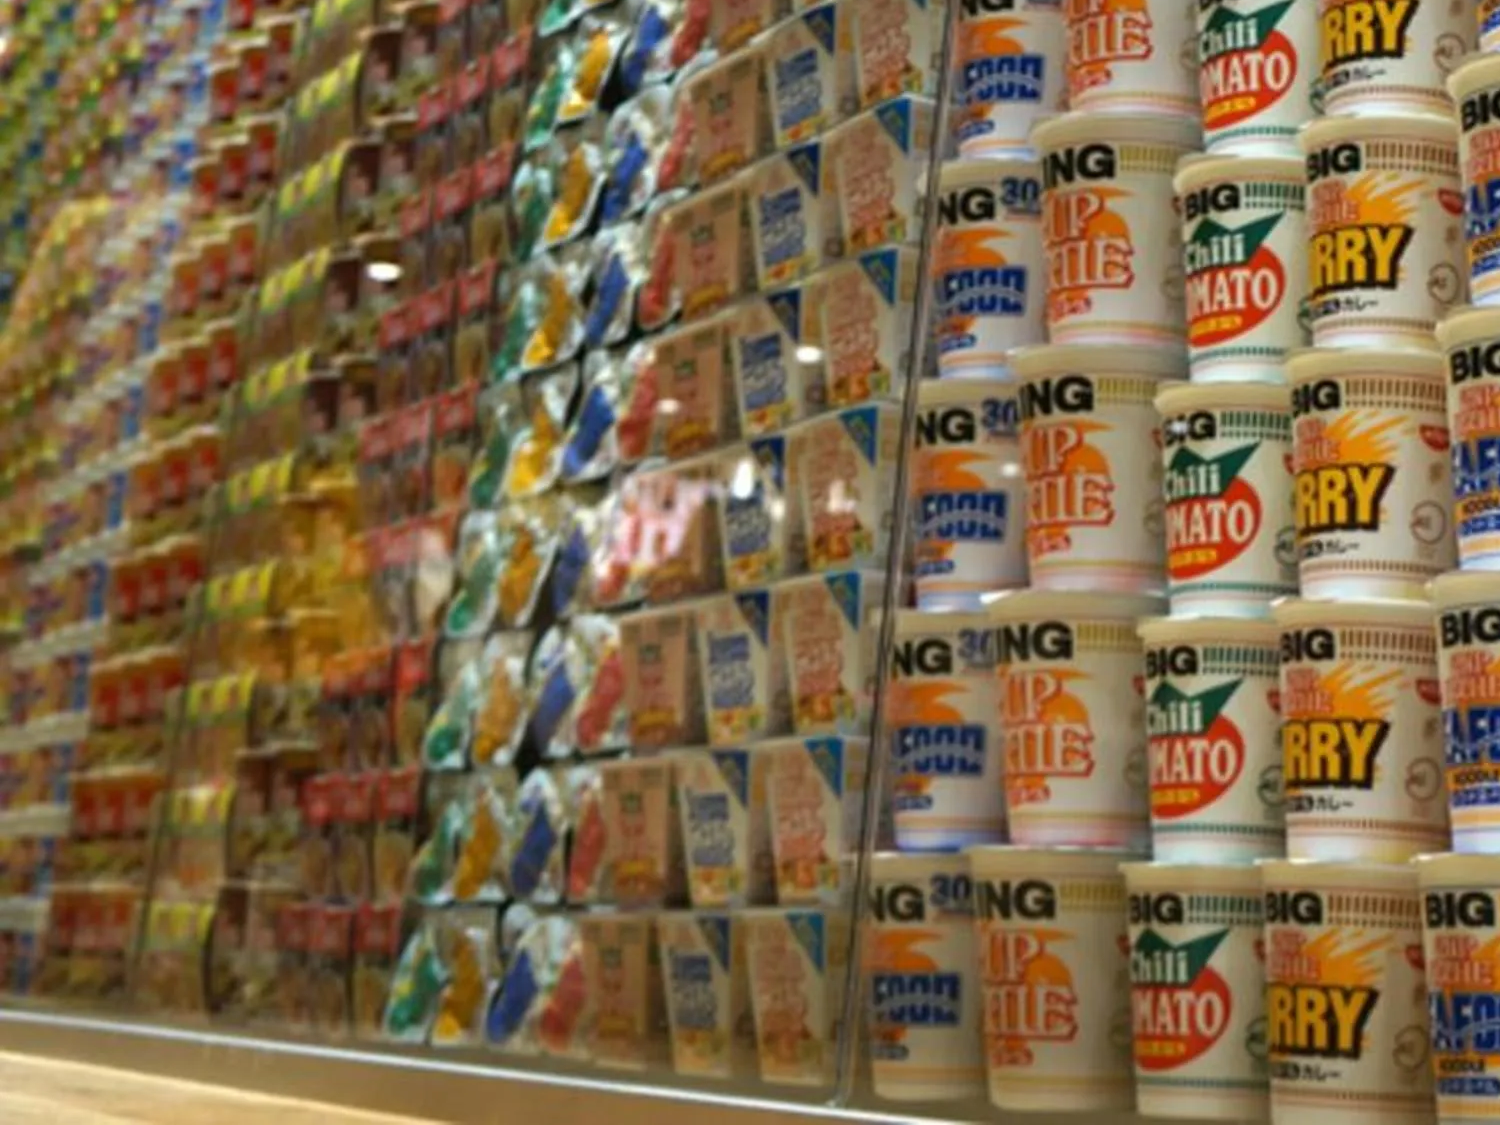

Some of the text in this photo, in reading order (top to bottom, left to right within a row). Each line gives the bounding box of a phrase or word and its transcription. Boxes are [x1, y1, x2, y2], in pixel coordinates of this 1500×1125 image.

[1186, 181, 1240, 218] BIG
[1146, 645, 1197, 676] BIG
[1128, 893, 1183, 925] BIG
[1426, 891, 1497, 928] BIG
